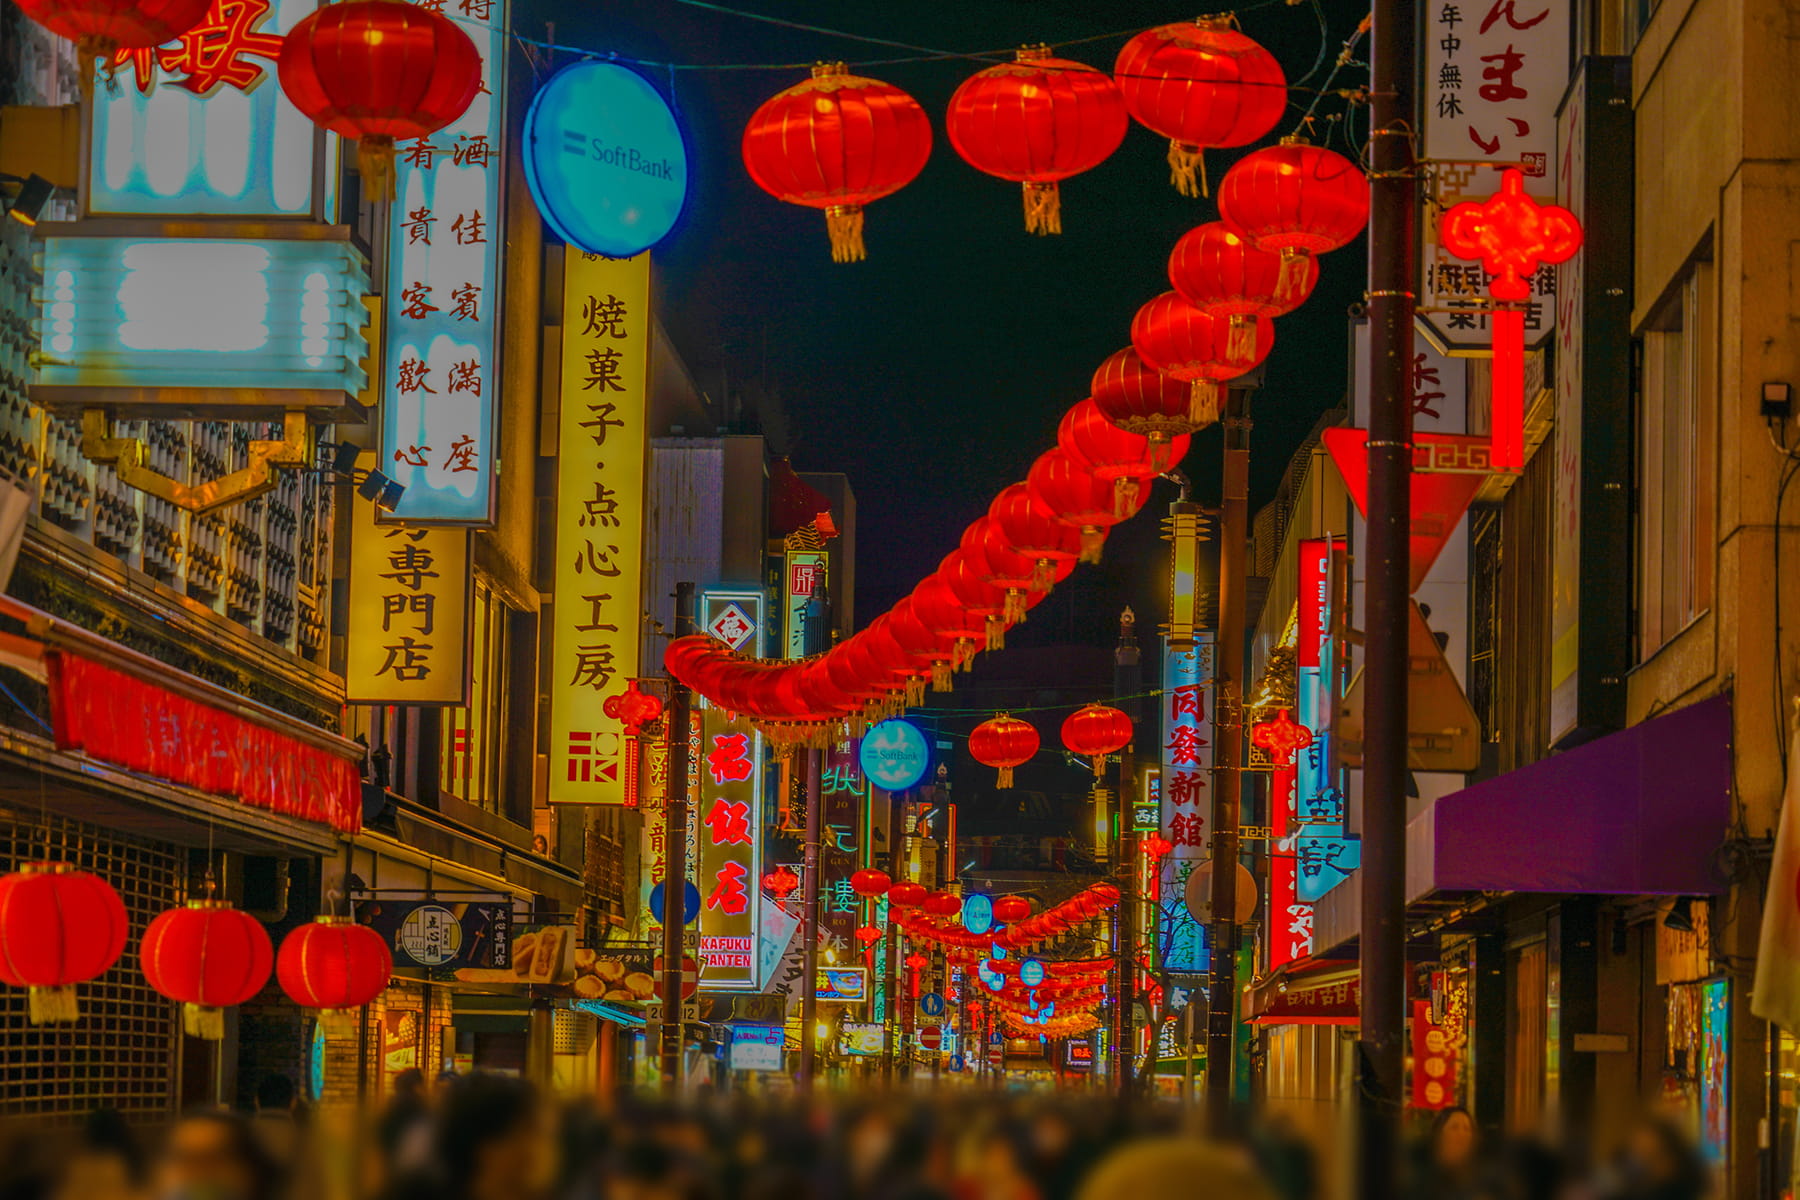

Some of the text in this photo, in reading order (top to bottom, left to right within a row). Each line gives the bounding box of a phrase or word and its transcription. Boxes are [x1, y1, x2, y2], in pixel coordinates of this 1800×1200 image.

[1437, 3, 1464, 119] 年中無休
[591, 137, 675, 182] SoftBank
[1428, 263, 1557, 296] 横浜街
[1447, 301, 1543, 330] 東店
[568, 294, 629, 692] 焼菓子・点心工房
[878, 747, 919, 761] SoftBank
[1165, 686, 1208, 848] 同發新館
[704, 716, 754, 915] 福飯店
[834, 801, 849, 810] JO
[830, 858, 850, 866] GEN
[832, 918, 847, 927] RO
[700, 938, 752, 950] KAFUKU
[600, 953, 650, 963] エッグタルト
[1285, 982, 1362, 1008] 謝甜
